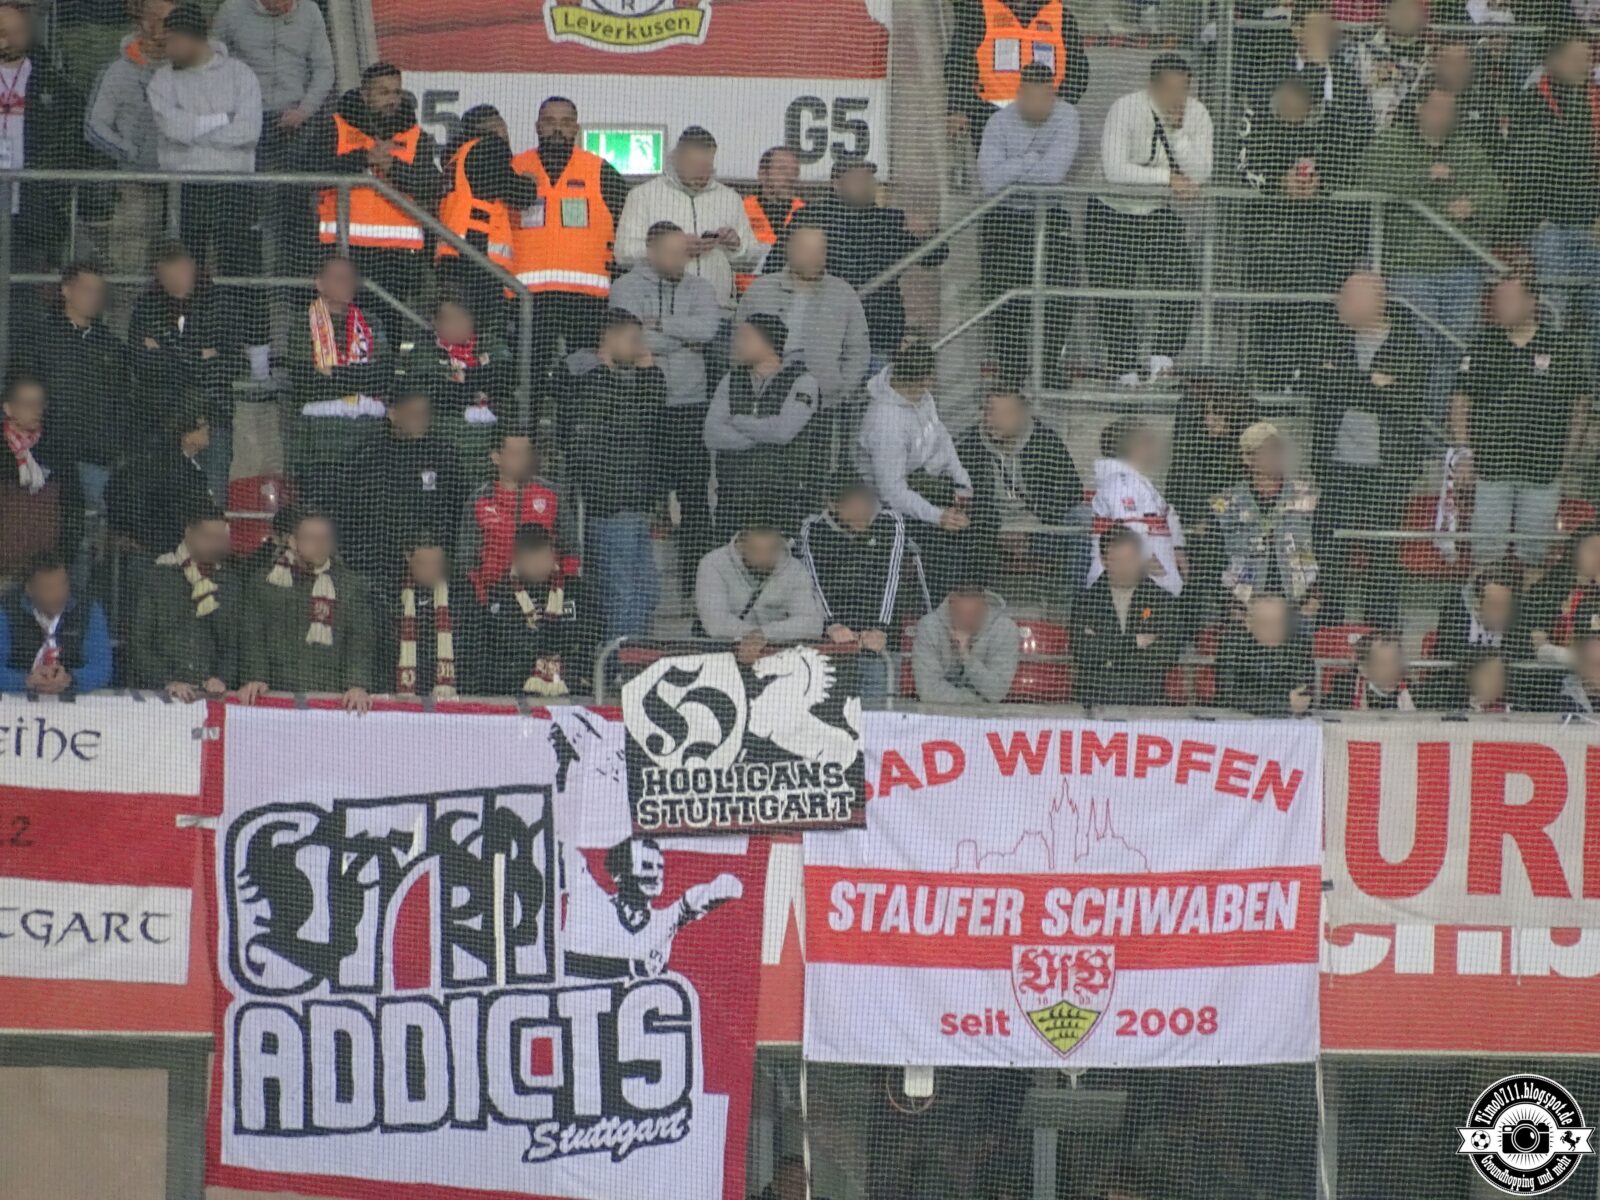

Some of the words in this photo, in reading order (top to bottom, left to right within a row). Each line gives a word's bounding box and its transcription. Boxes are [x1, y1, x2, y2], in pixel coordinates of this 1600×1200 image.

[564, 11, 691, 40] Leverkusen
[784, 95, 870, 164] G5
[642, 761, 846, 798] HOOLIGANS
[862, 740, 966, 802] AD
[986, 729, 1303, 812] WIMPFEN
[637, 788, 855, 830] STUTTGART
[828, 881, 1025, 937] STAUFER
[1041, 880, 1300, 938] SCHWABEN
[940, 1007, 1012, 1037] seit
[1115, 1006, 1219, 1037] 2008
[231, 974, 694, 1136] ADDICTS
[525, 1106, 690, 1162] Stuttgart
